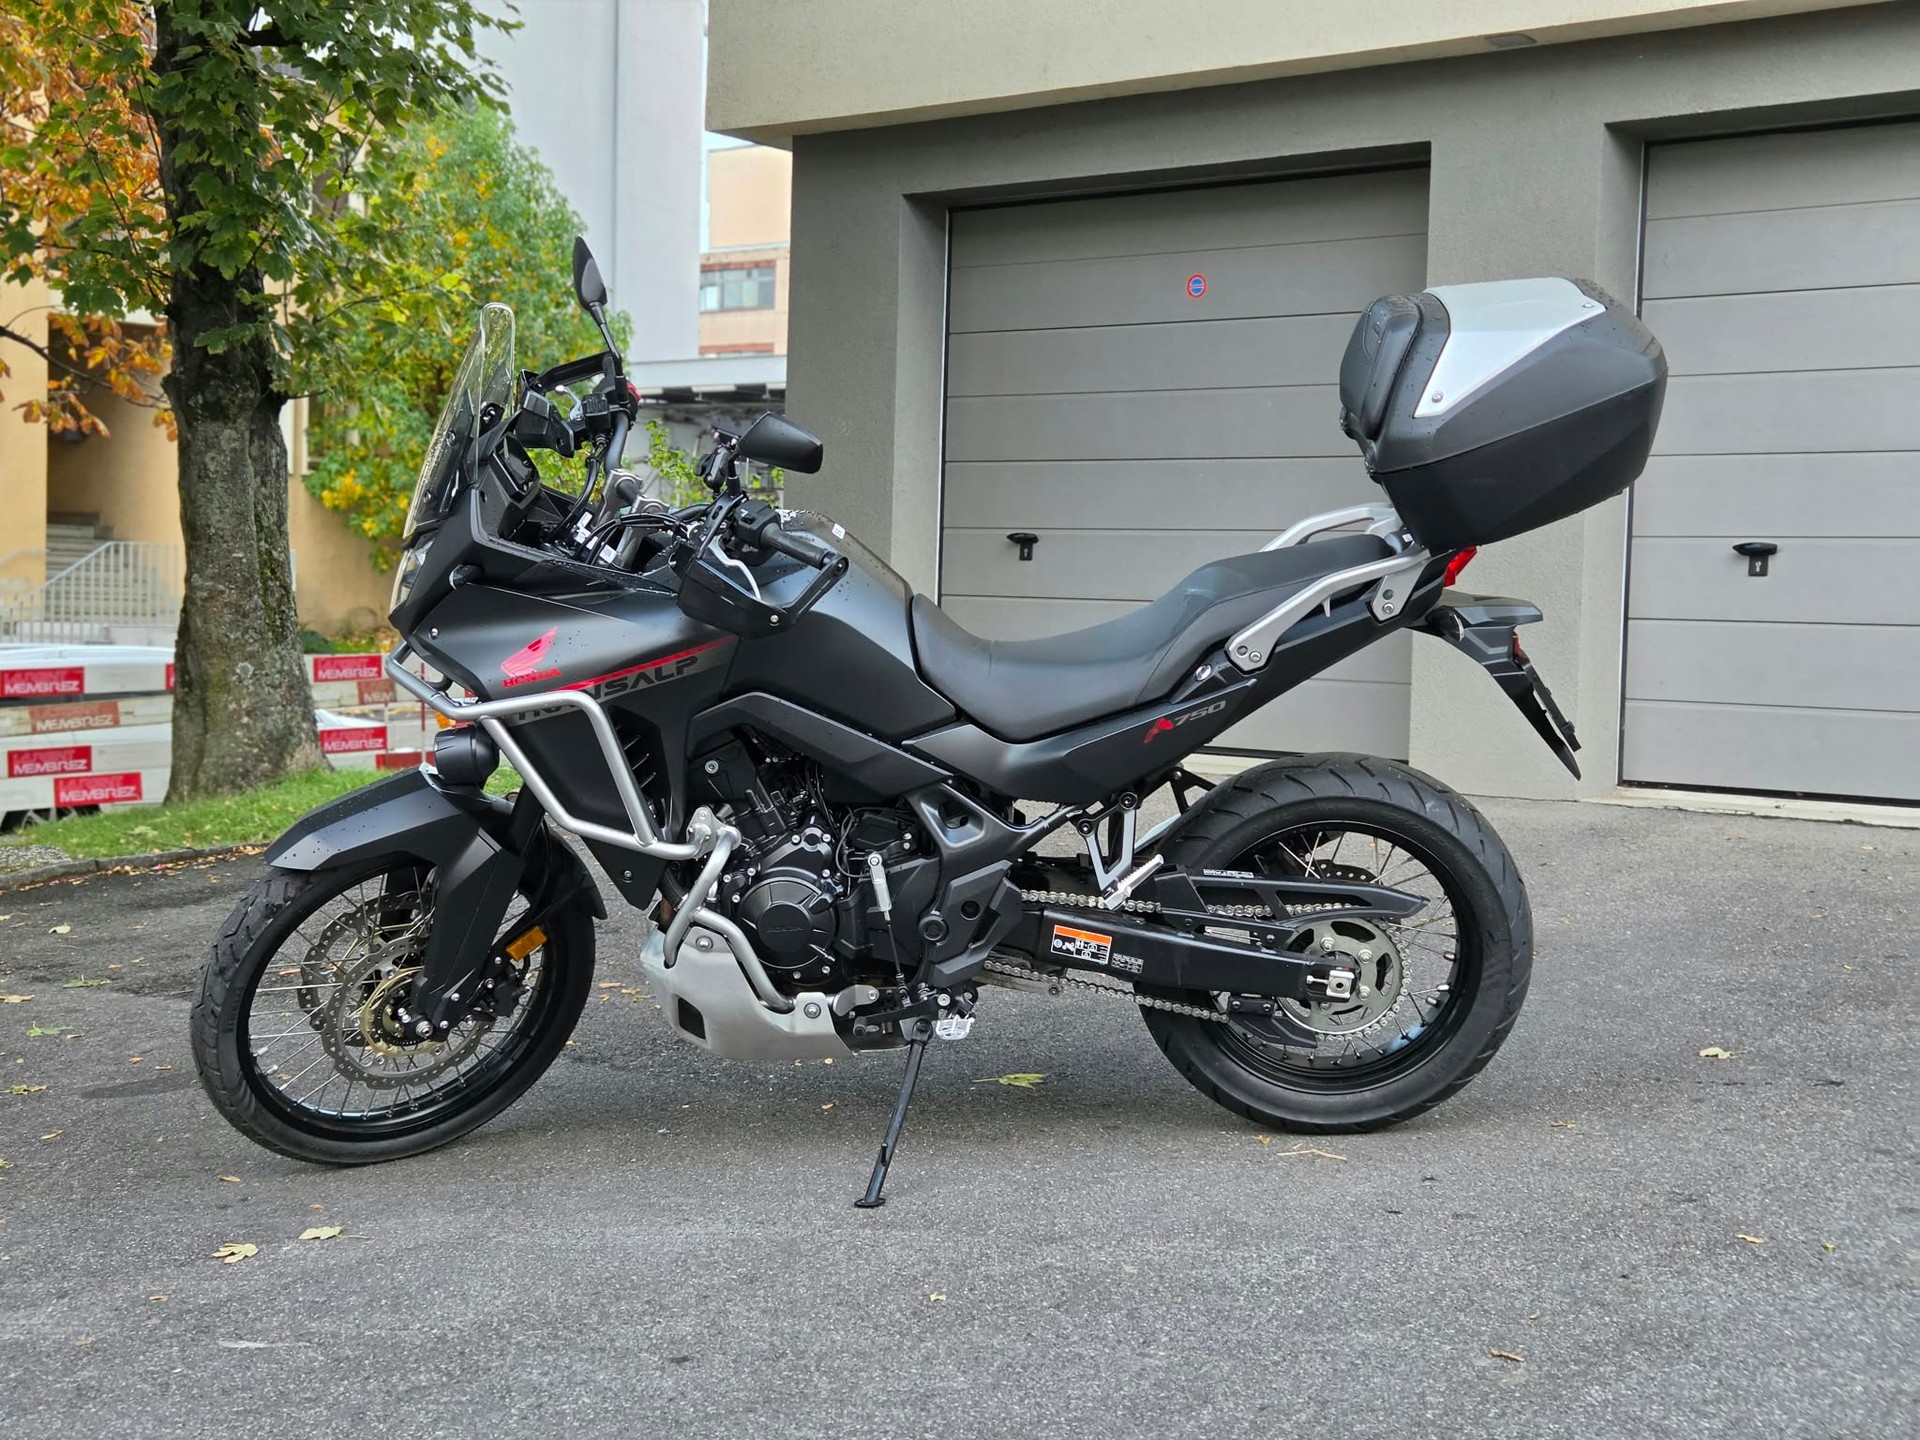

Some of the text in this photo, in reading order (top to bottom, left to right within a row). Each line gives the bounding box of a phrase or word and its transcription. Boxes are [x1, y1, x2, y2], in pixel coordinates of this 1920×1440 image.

[502, 668, 563, 688] HONDA
[5, 681, 79, 694] MEMBREZ
[1175, 700, 1226, 727] 750
[35, 714, 113, 732] MEMBREZ
[13, 759, 88, 776] MEMBREZ
[59, 785, 137, 803] MEMBREZ
